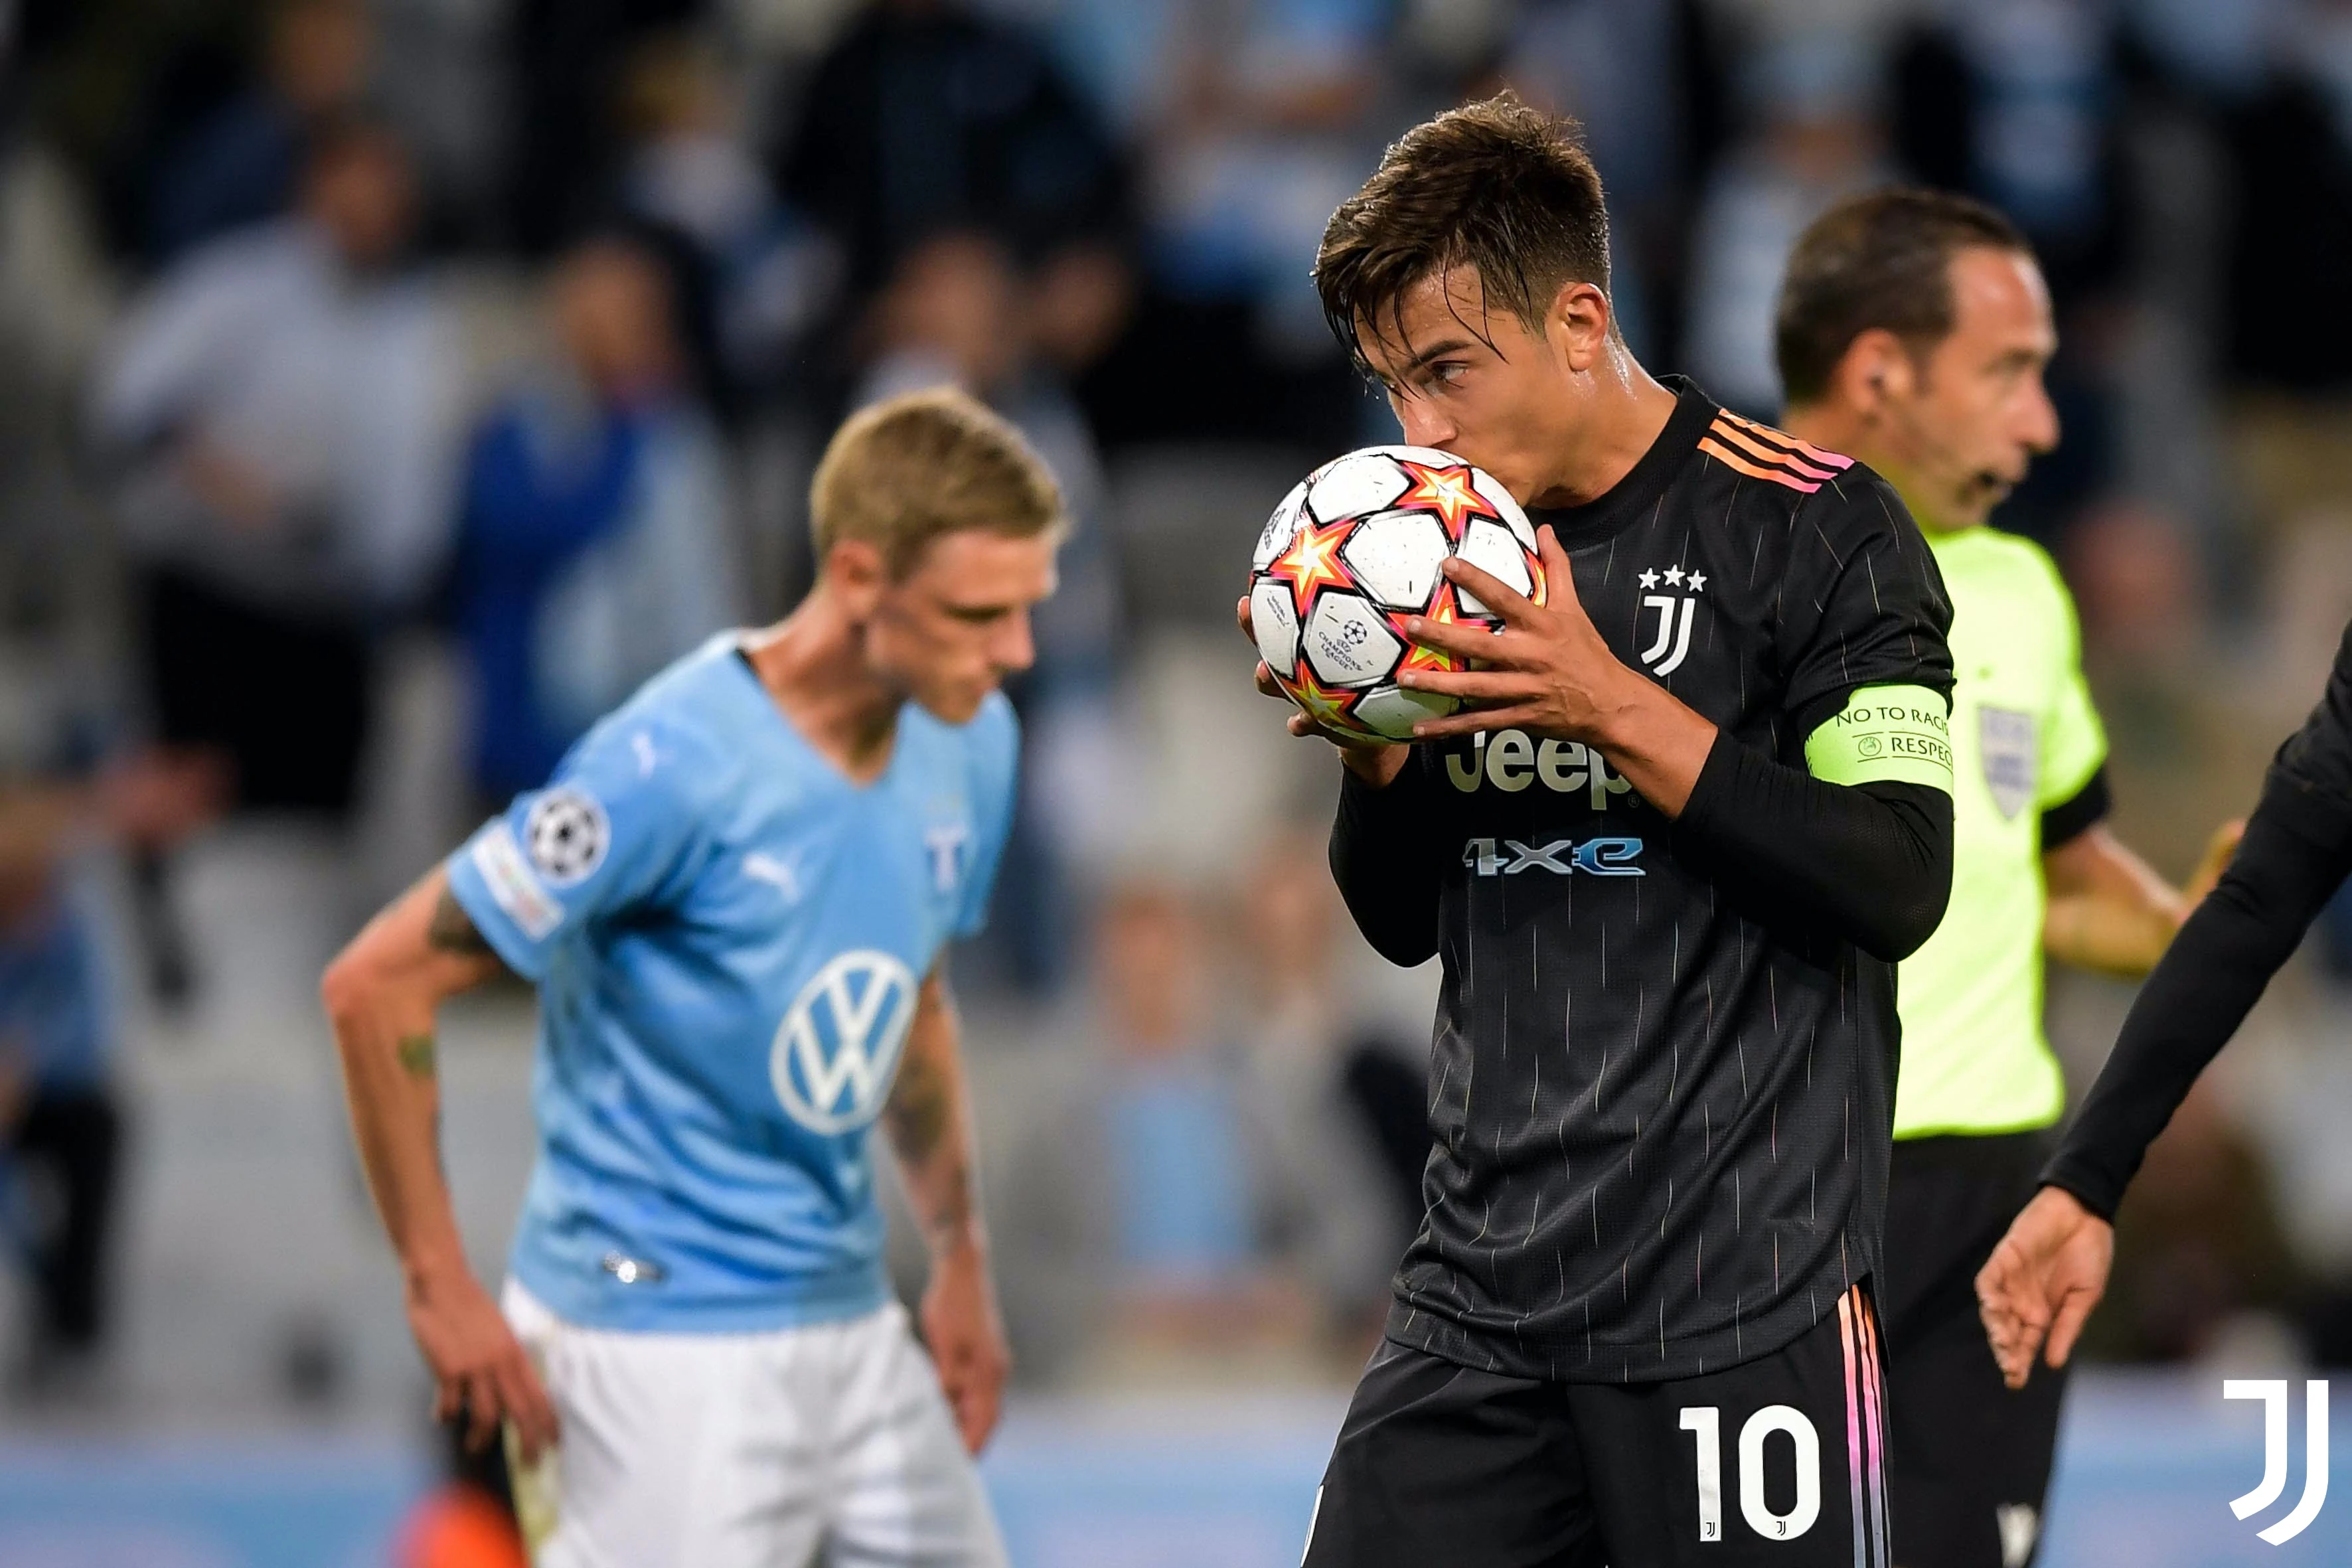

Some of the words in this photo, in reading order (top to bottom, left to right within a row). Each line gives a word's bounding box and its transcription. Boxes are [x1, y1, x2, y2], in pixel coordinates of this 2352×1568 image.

[1318, 631, 1364, 671] CHAMPIONS
[1320, 643, 1352, 670] LEAGUE
[1836, 708, 1871, 728] NO
[1876, 707, 1905, 720] TO
[1680, 1404, 1820, 1542] 10
